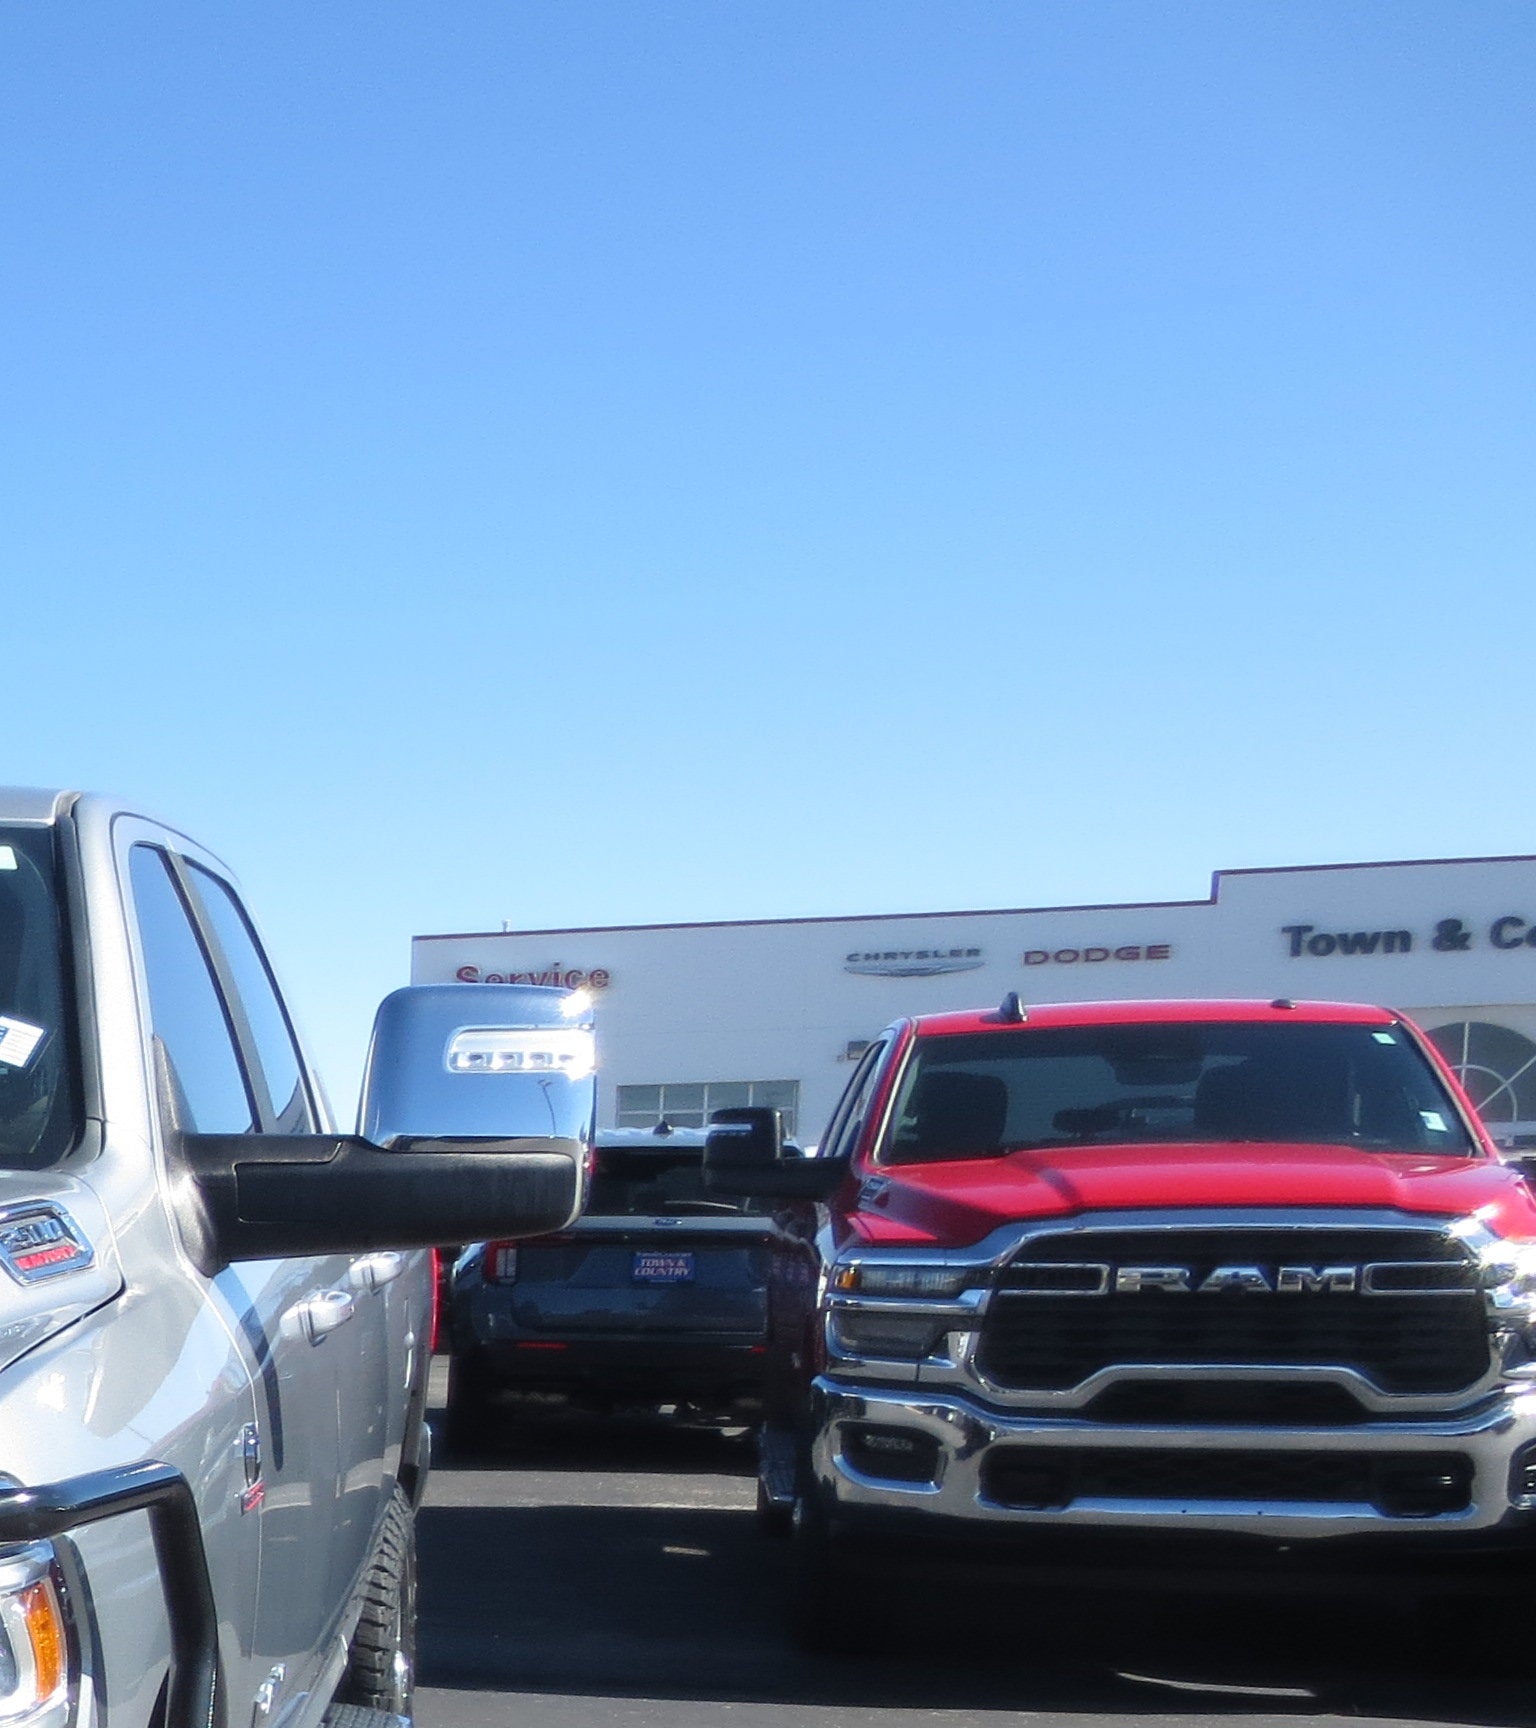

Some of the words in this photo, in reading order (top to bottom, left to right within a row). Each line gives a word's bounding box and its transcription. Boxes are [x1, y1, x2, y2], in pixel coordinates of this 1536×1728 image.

[1281, 924, 1412, 957] Town
[1431, 918, 1471, 951] &
[845, 948, 981, 962] CHRYSLER
[1023, 944, 1172, 966] DODGE
[1116, 1266, 1356, 1292] RAM
